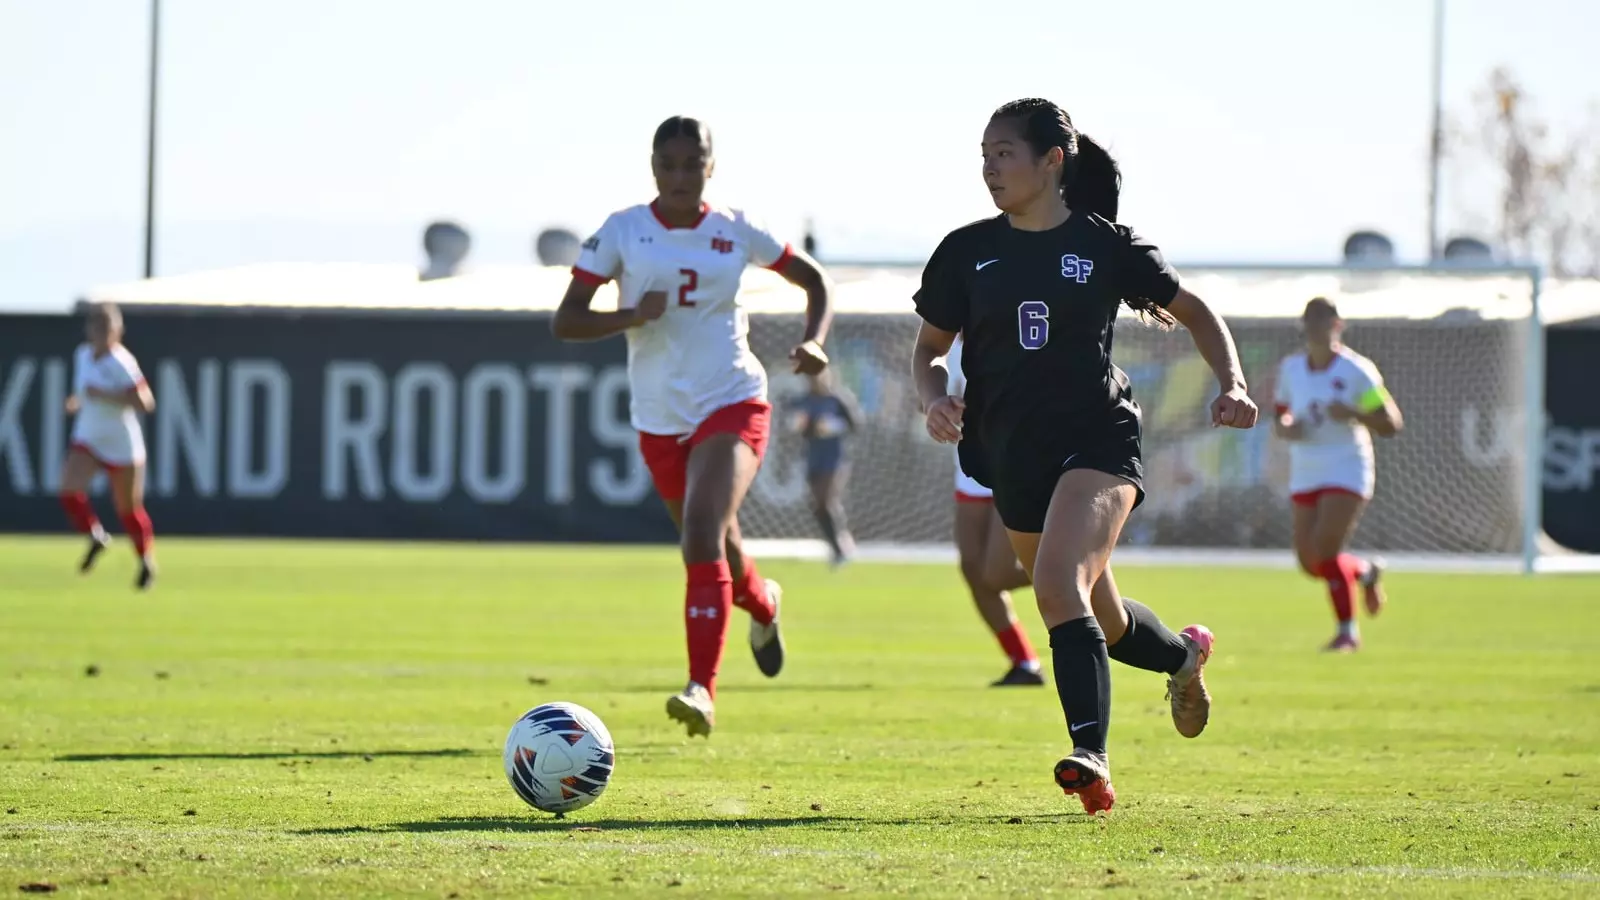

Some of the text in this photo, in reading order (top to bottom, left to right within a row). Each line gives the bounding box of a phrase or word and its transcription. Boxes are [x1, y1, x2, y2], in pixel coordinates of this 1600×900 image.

[679, 268, 698, 307] 2
[1061, 254, 1093, 283] SF
[1018, 301, 1049, 349] 6
[0, 356, 651, 506] KLND ROOTS
